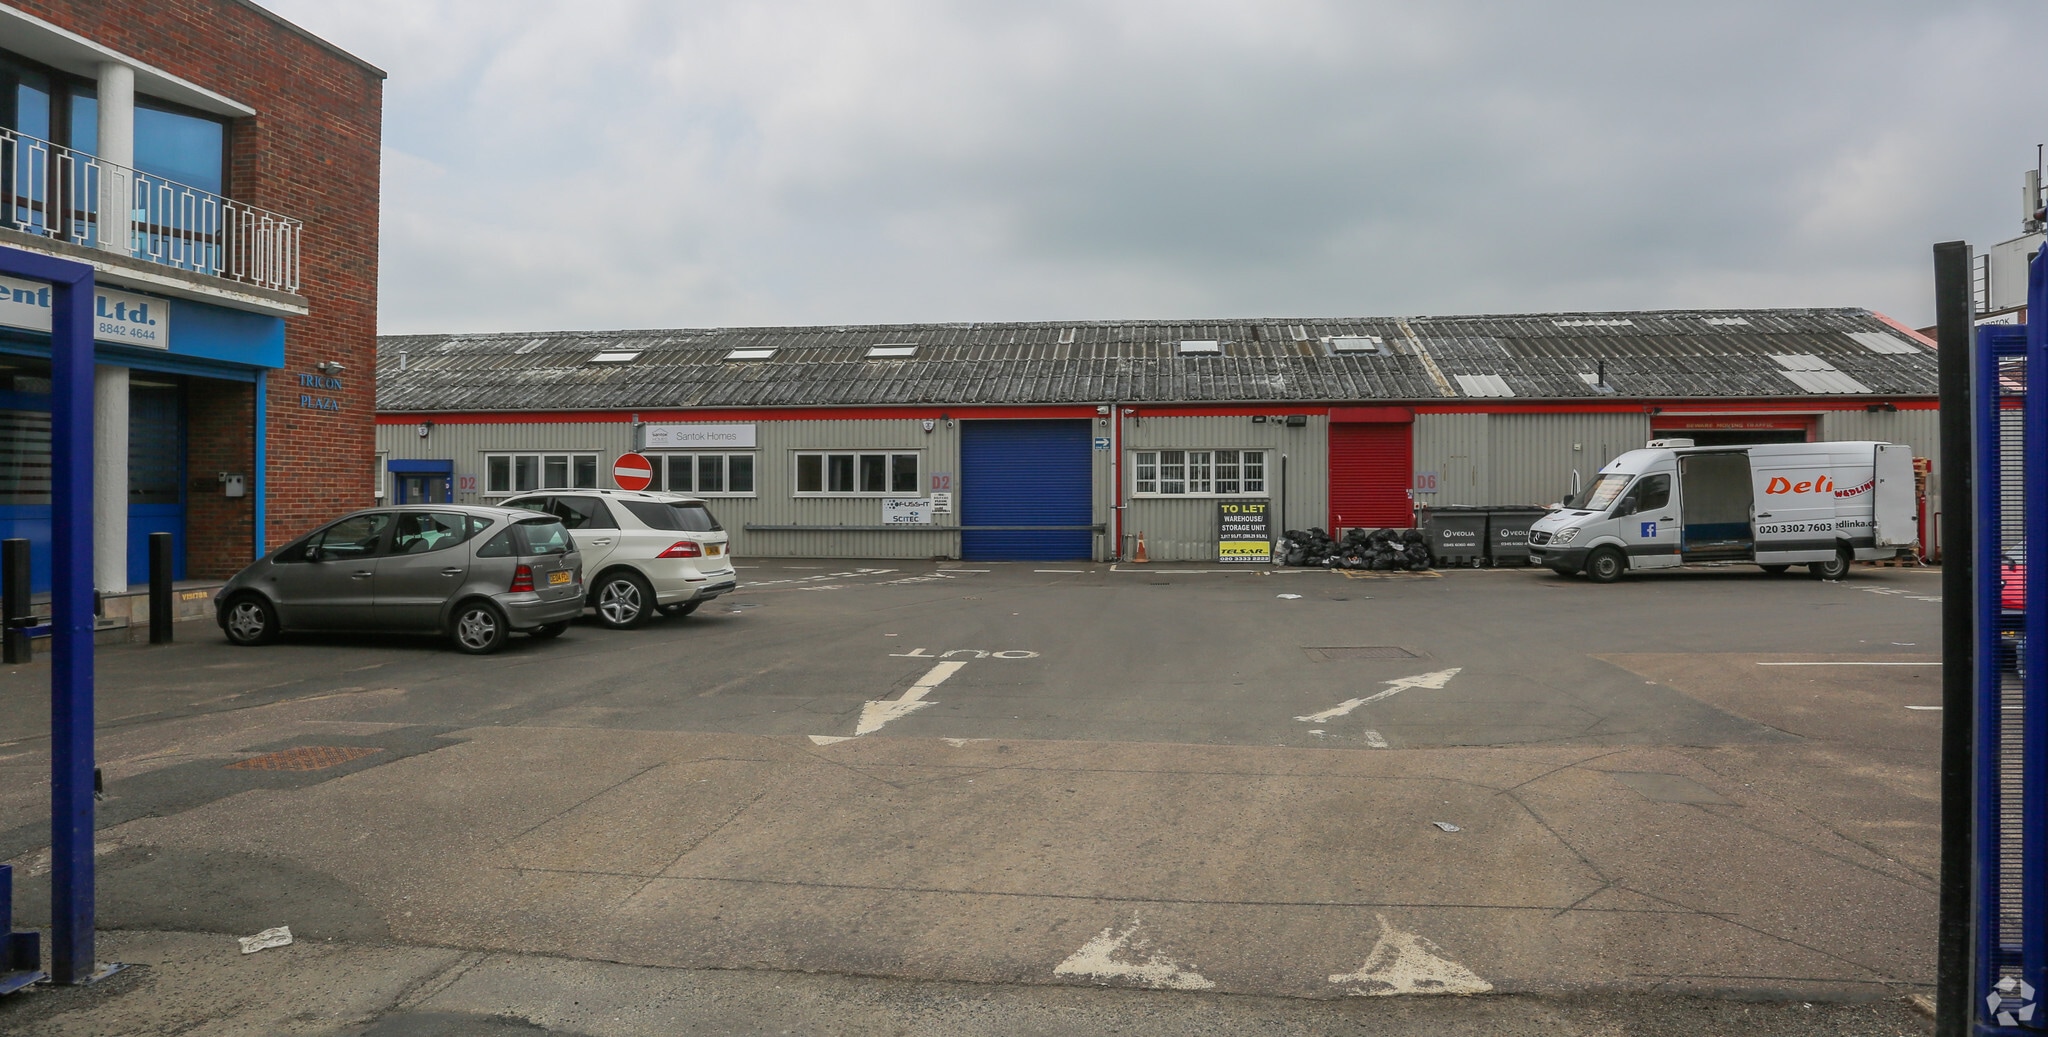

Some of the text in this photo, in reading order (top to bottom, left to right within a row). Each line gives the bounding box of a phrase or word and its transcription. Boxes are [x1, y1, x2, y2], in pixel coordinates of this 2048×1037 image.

[96, 295, 156, 326] Ltd.
[99, 323, 155, 340] 8842 4644
[297, 373, 342, 390] TRICON
[300, 394, 339, 411] PLAZA
[676, 431, 737, 441] Santok Homes
[460, 476, 475, 490] D2
[932, 475, 950, 490] D2
[1417, 475, 1436, 489] D6
[1765, 474, 1834, 495] Deli
[1221, 504, 1266, 513] TO LET
[1759, 523, 1832, 534] 020 3302 7603
[182, 591, 208, 600] VISITOR
[889, 647, 1041, 659] OUT
